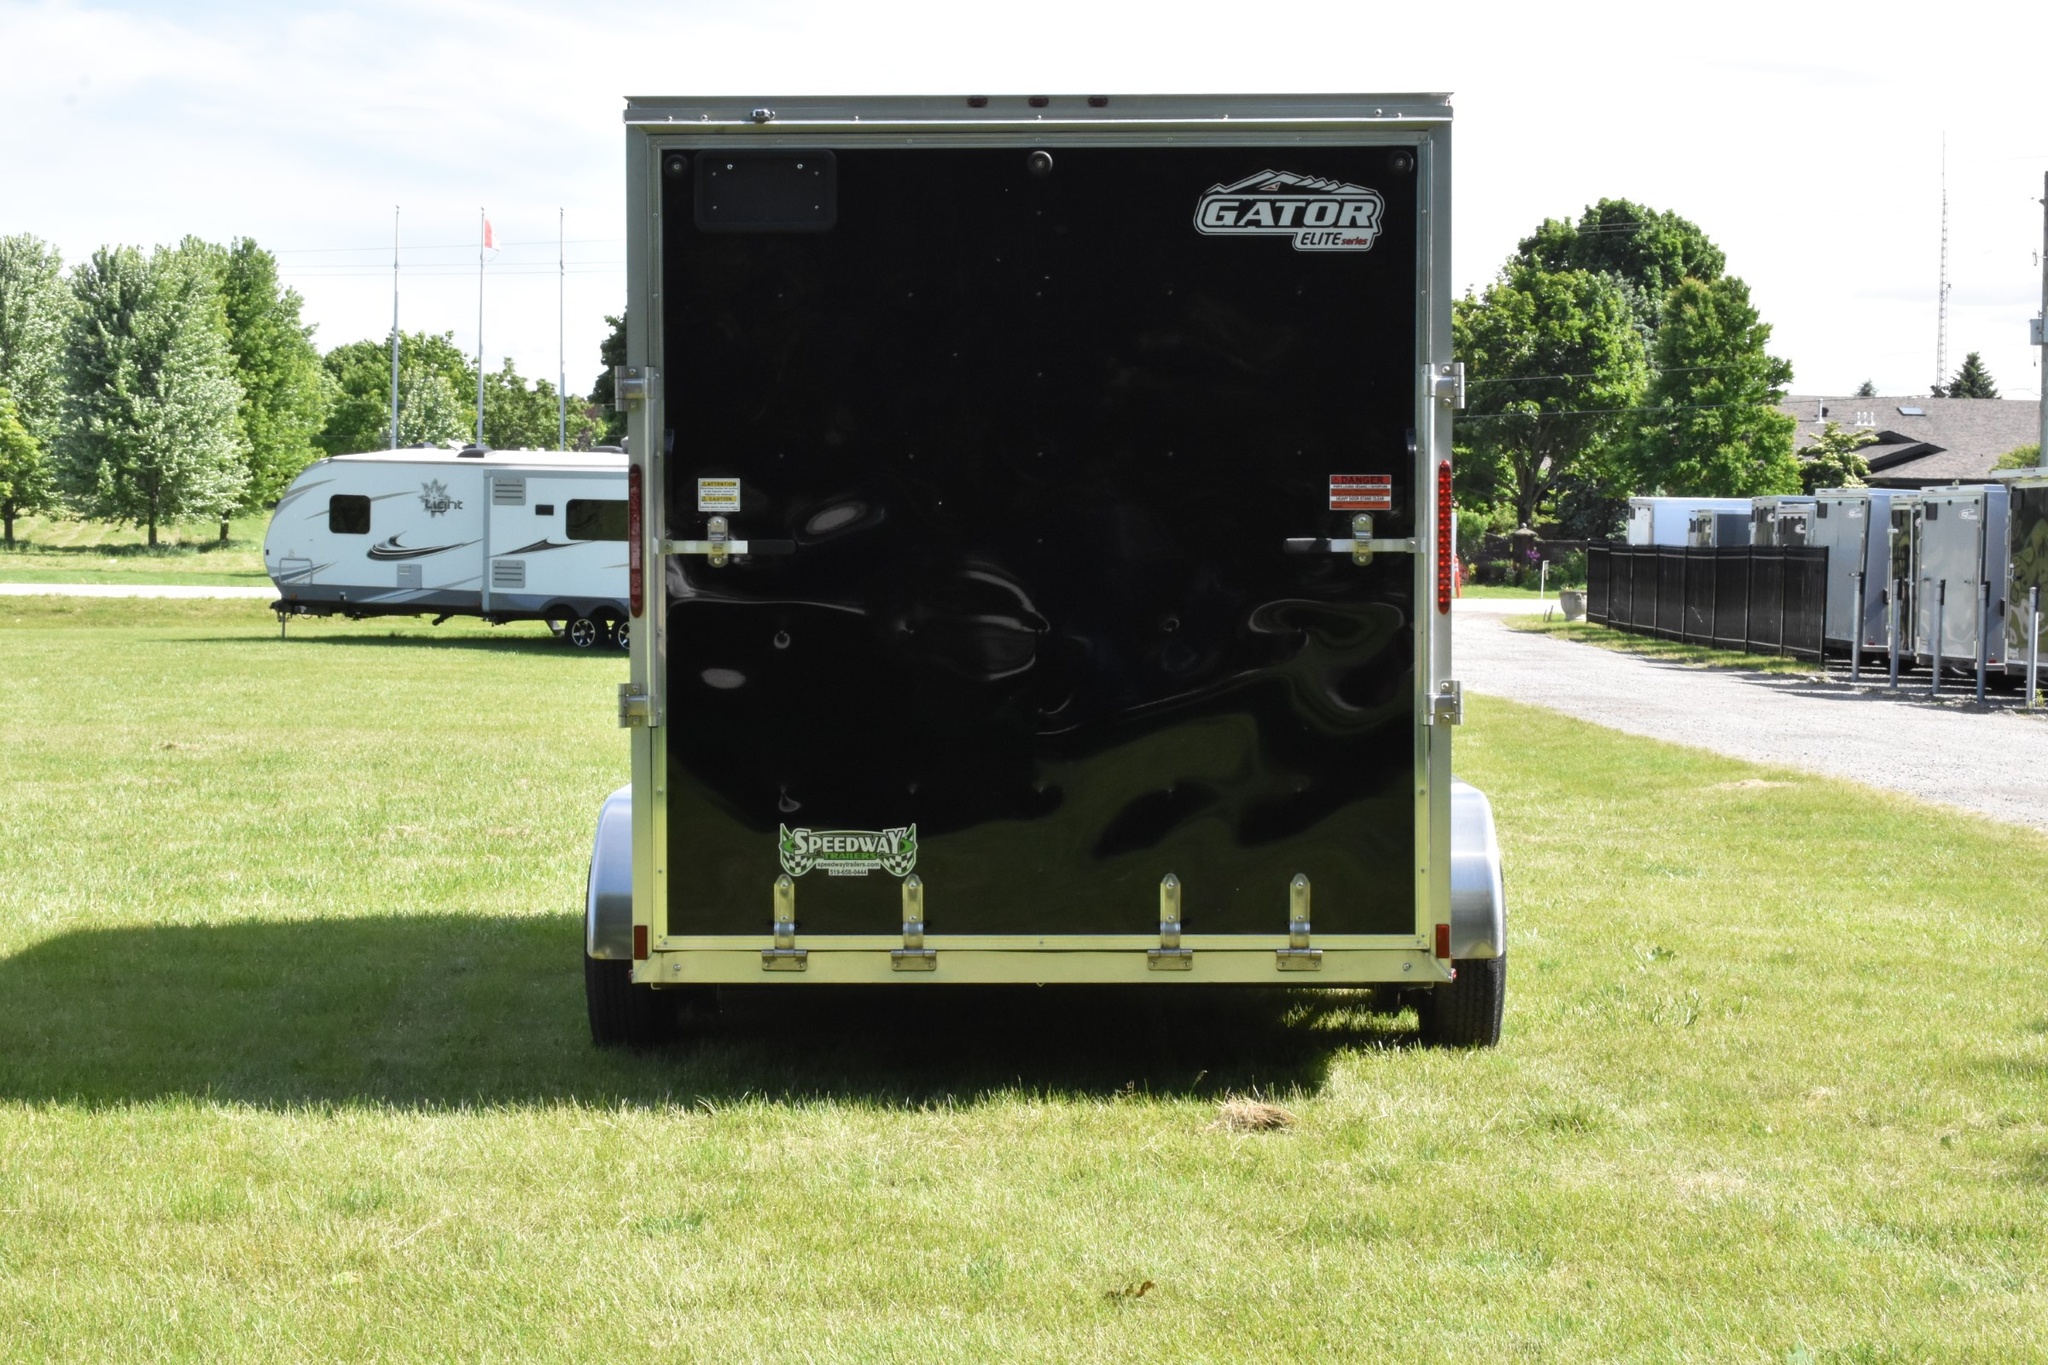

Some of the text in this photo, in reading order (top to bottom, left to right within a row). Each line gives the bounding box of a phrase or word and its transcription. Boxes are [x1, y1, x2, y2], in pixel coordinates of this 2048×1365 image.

[1203, 201, 1375, 227] GATOR
[1300, 232, 1368, 246] ELITE series
[1341, 476, 1384, 484] DANGER
[793, 830, 903, 855] SPEEDWAY
[823, 852, 878, 860] TRAILERS
[817, 860, 880, 868] speedwaytrailers.com
